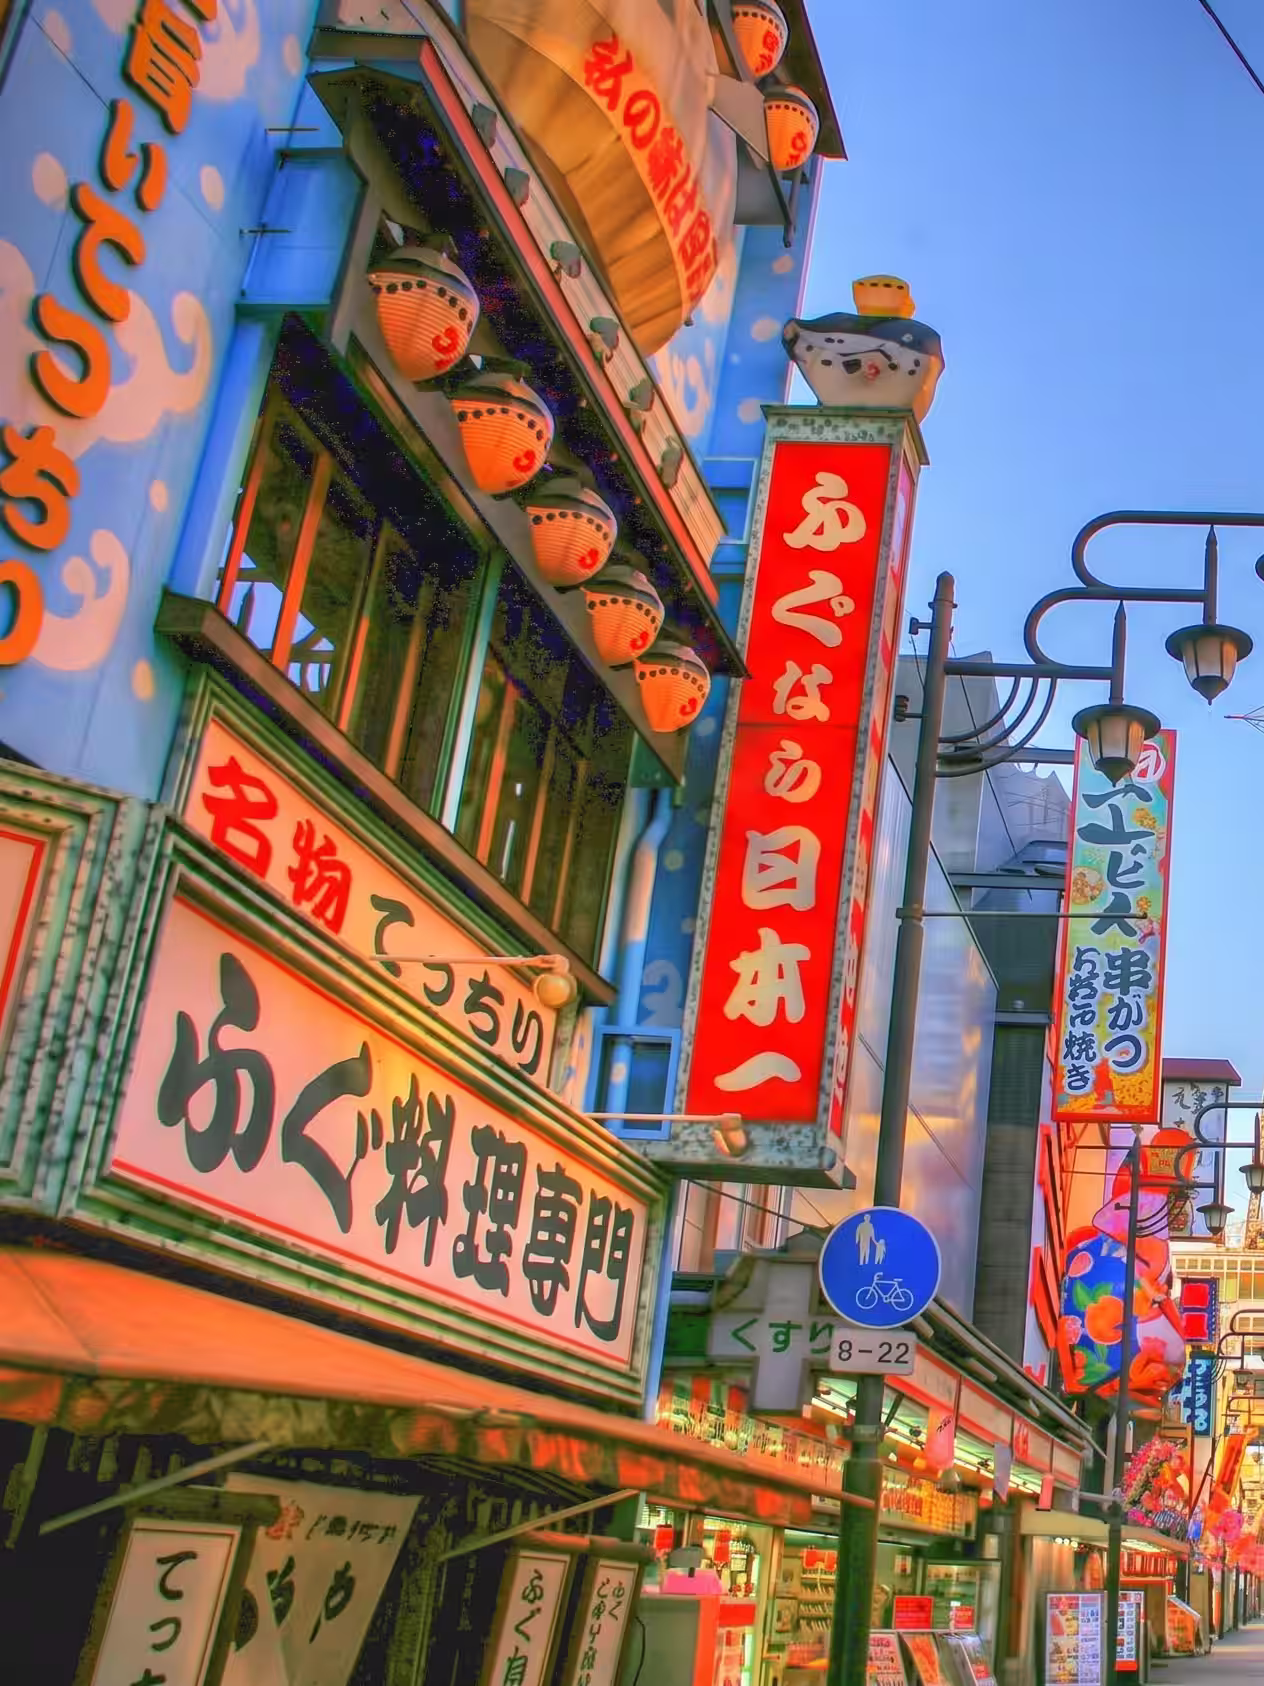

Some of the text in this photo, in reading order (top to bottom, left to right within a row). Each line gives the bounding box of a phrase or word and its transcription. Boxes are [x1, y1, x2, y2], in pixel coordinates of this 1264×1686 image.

[714, 471, 867, 1092] ふぐなら日本一
[157, 952, 635, 1341] ふぐ料理専門
[731, 1318, 834, 1354] くすり
[838, 1340, 909, 1365] 8-22
